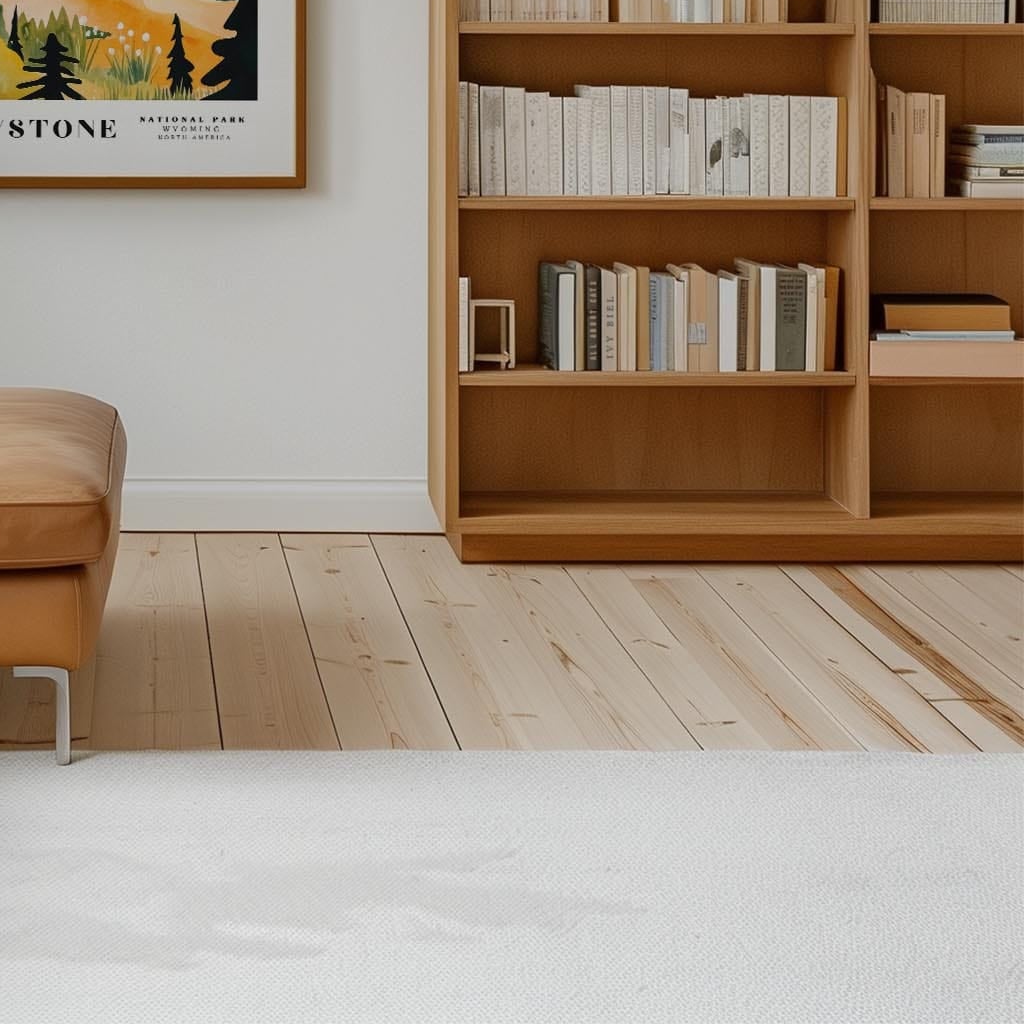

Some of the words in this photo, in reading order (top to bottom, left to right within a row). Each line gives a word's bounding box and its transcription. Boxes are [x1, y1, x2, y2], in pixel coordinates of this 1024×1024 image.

[606, 295, 615, 328] BIEL
[589, 344, 598, 361] ALL
[606, 335, 615, 360] IVY
